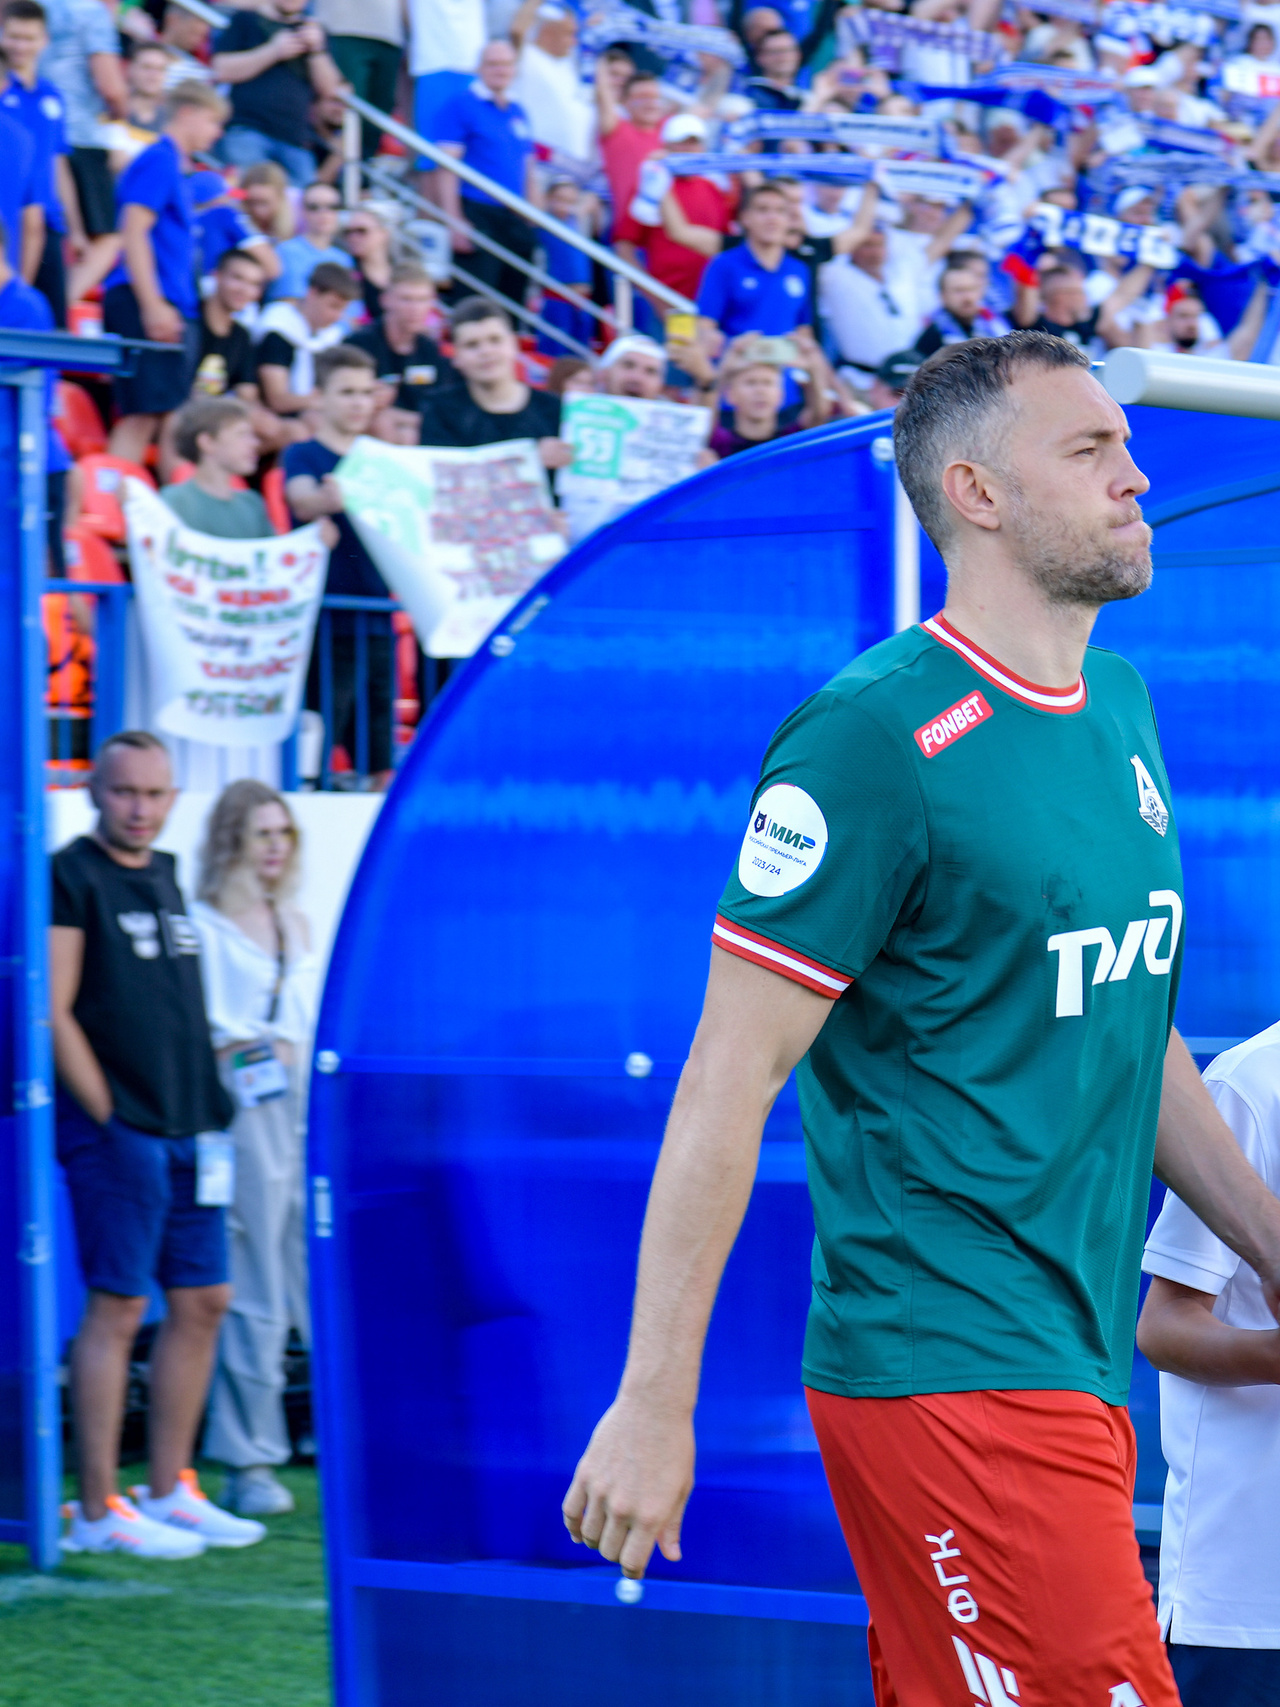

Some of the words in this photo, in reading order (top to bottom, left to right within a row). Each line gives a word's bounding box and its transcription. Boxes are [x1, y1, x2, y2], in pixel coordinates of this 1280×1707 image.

[921, 695, 984, 753] FONBET
[769, 822, 816, 850] МИР
[752, 856, 781, 876] 2023/24
[924, 1529, 980, 1623] ФГК
